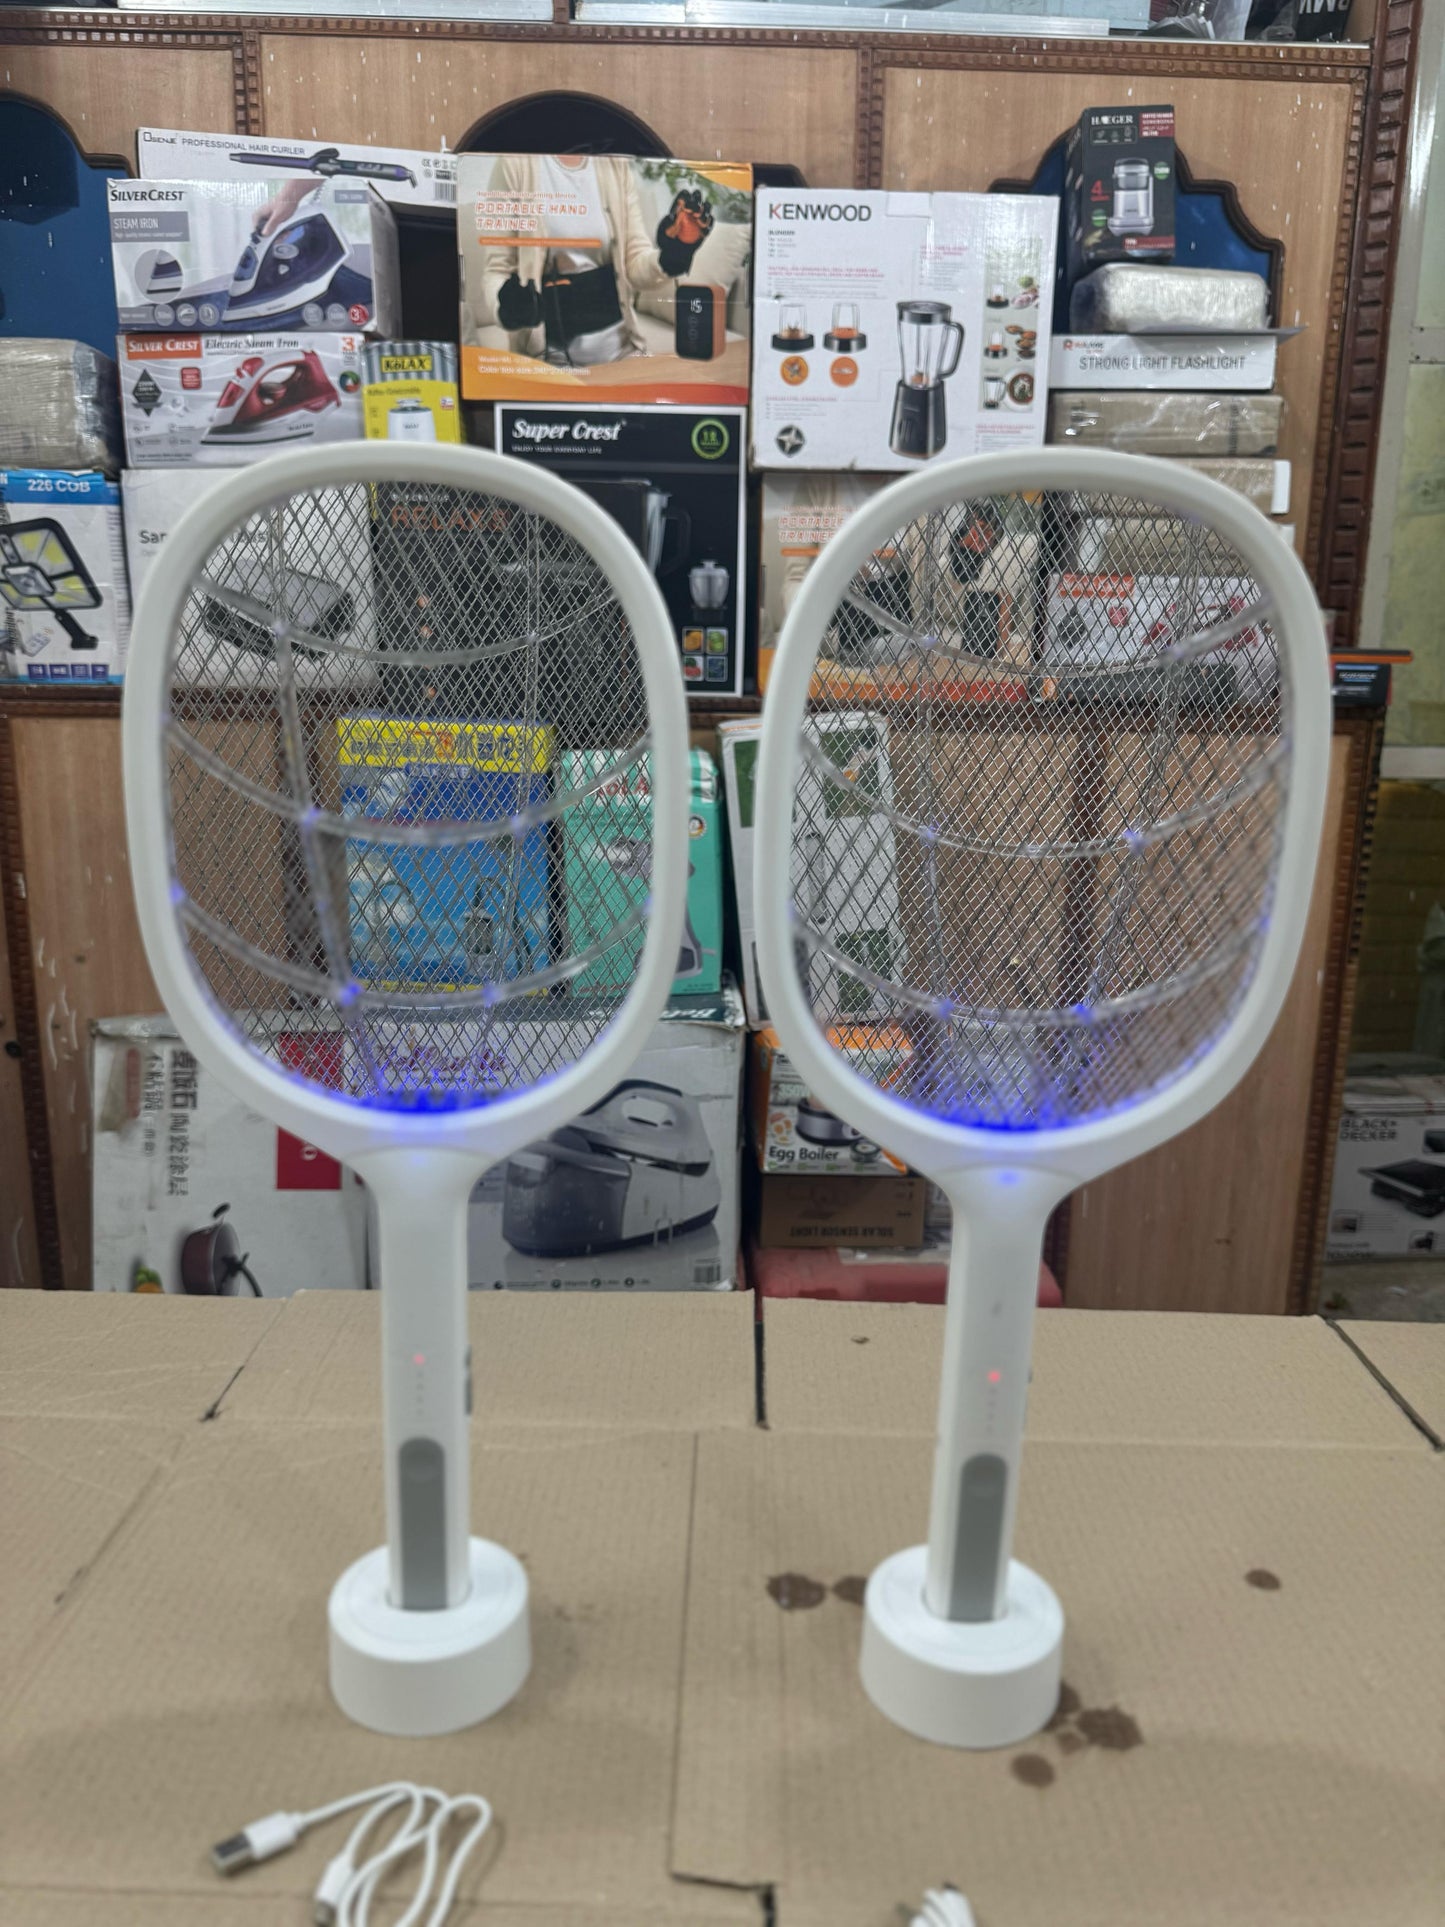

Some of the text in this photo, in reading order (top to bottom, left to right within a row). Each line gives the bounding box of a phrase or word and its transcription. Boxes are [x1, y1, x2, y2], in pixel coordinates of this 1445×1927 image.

[182, 137, 247, 150] PROFESSIONAL
[249, 143, 270, 153] HAIR
[271, 145, 305, 155] CURLER
[476, 201, 589, 216] PORTABLE HAND
[769, 203, 872, 222] KENWOOD
[113, 218, 159, 230] STEAM IRON
[476, 217, 538, 231] TRAINER
[128, 338, 199, 352] SILVER CREST
[1079, 355, 1247, 371] STRONG LIGHT FLASHLIGHT
[512, 418, 621, 442] Super Crest
[56, 479, 91, 493] COB
[768, 1146, 839, 1162] Egg Boiler
